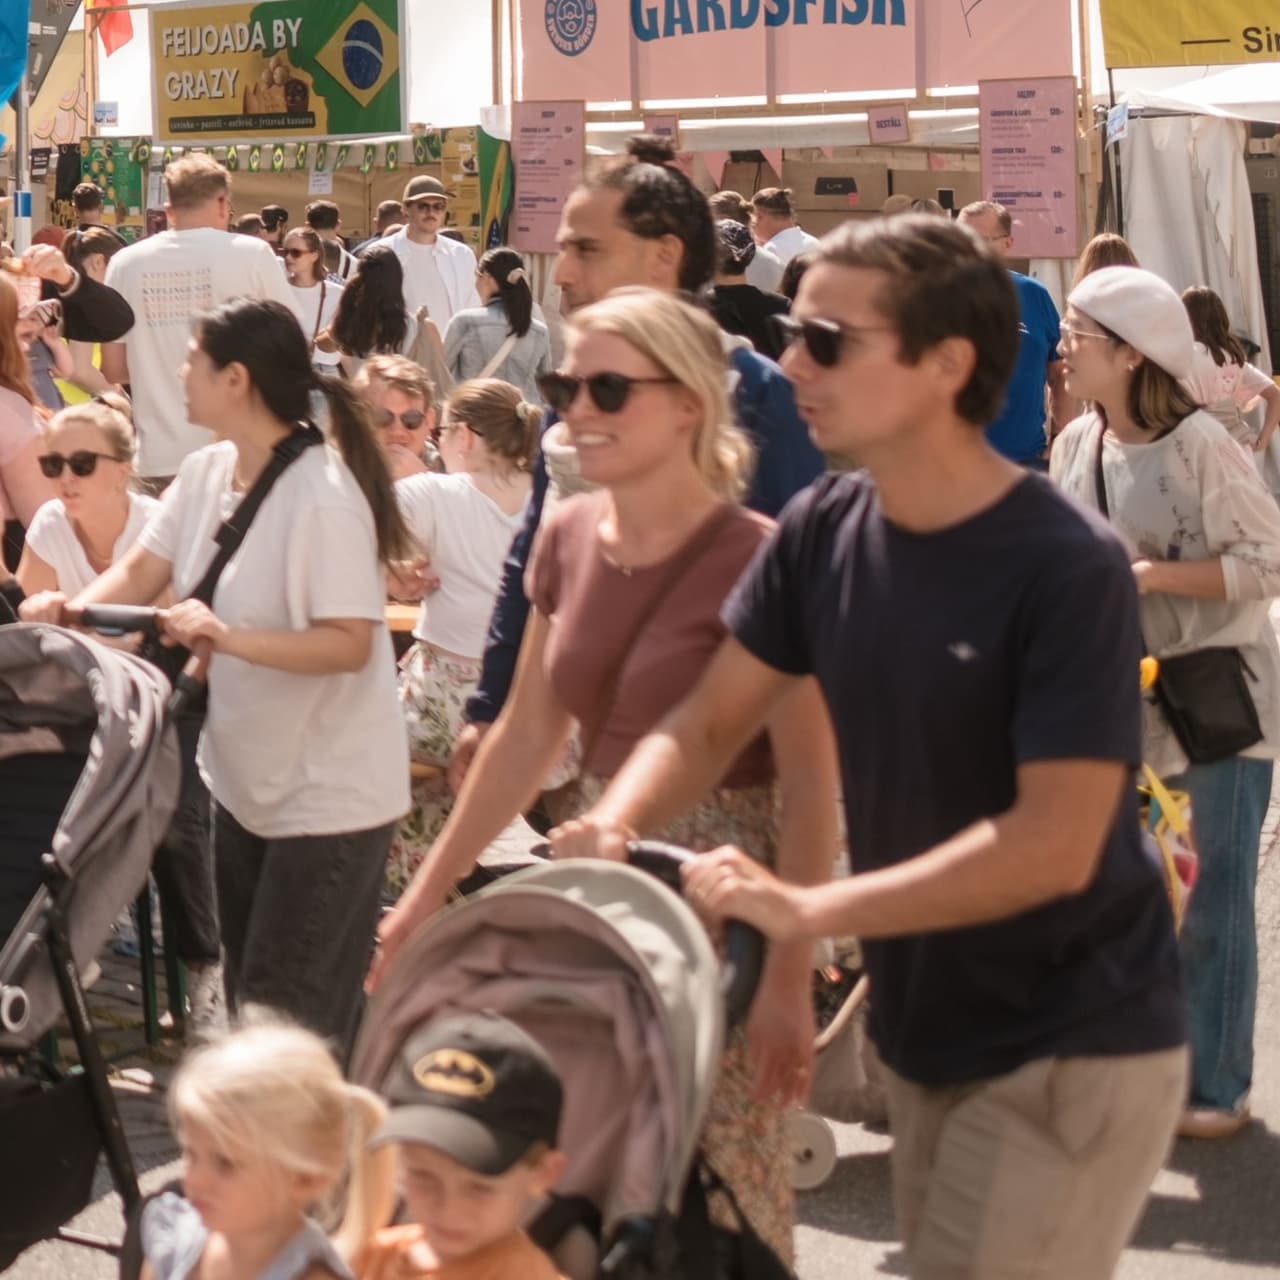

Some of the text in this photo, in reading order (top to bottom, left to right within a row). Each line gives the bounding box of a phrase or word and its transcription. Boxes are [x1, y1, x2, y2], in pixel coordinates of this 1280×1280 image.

[162, 17, 303, 57] FEIJOADA BY
[165, 68, 239, 101] GRAZY
